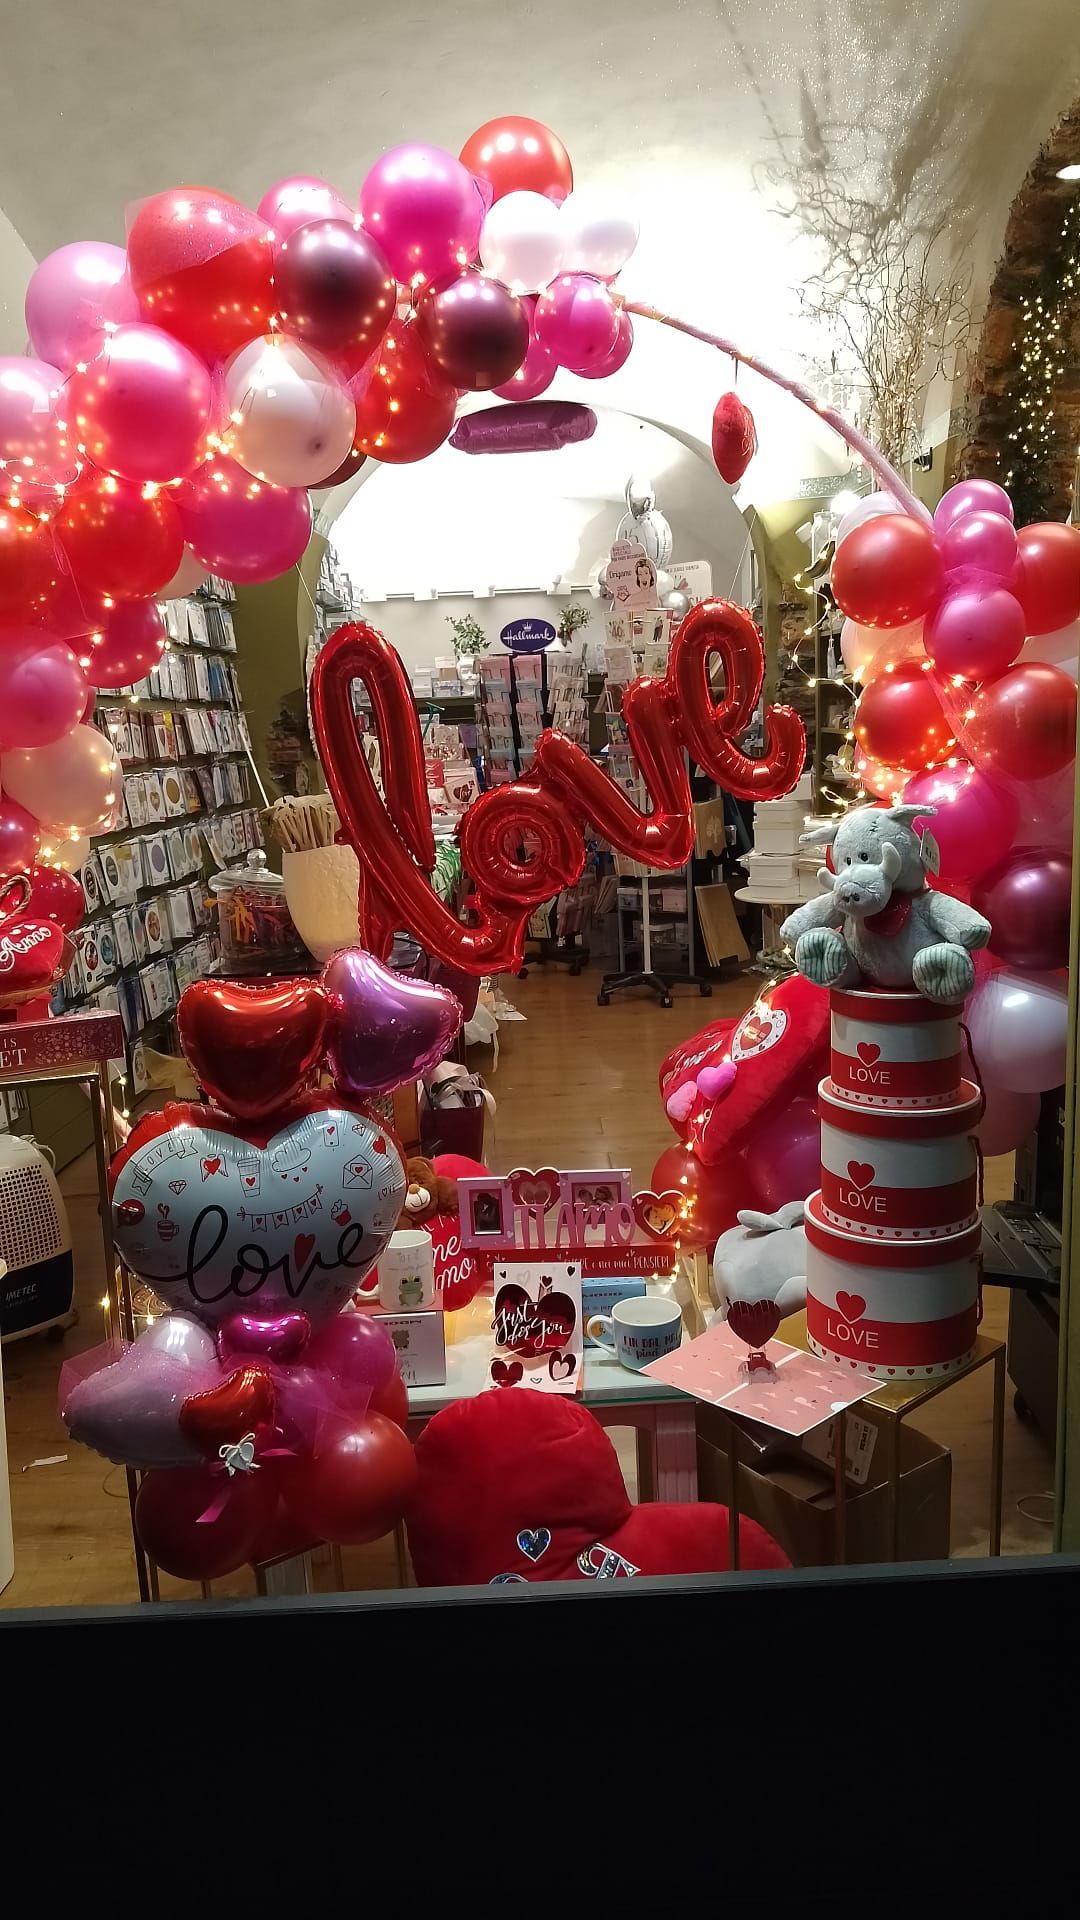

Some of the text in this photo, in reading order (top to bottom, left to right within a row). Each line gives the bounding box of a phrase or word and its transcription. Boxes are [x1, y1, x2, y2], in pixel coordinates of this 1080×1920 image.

[503, 628, 554, 647] Hallmark
[309, 597, 807, 977] love
[0, 1049, 27, 1069] ET
[849, 1066, 892, 1085] LOVE
[140, 1139, 176, 1172] LOVE
[839, 1187, 887, 1213] LOVE
[118, 1204, 387, 1305] love
[633, 1255, 669, 1269] PENSIERI
[5, 1283, 37, 1301] IMETEC
[827, 1318, 880, 1349] LOVE
